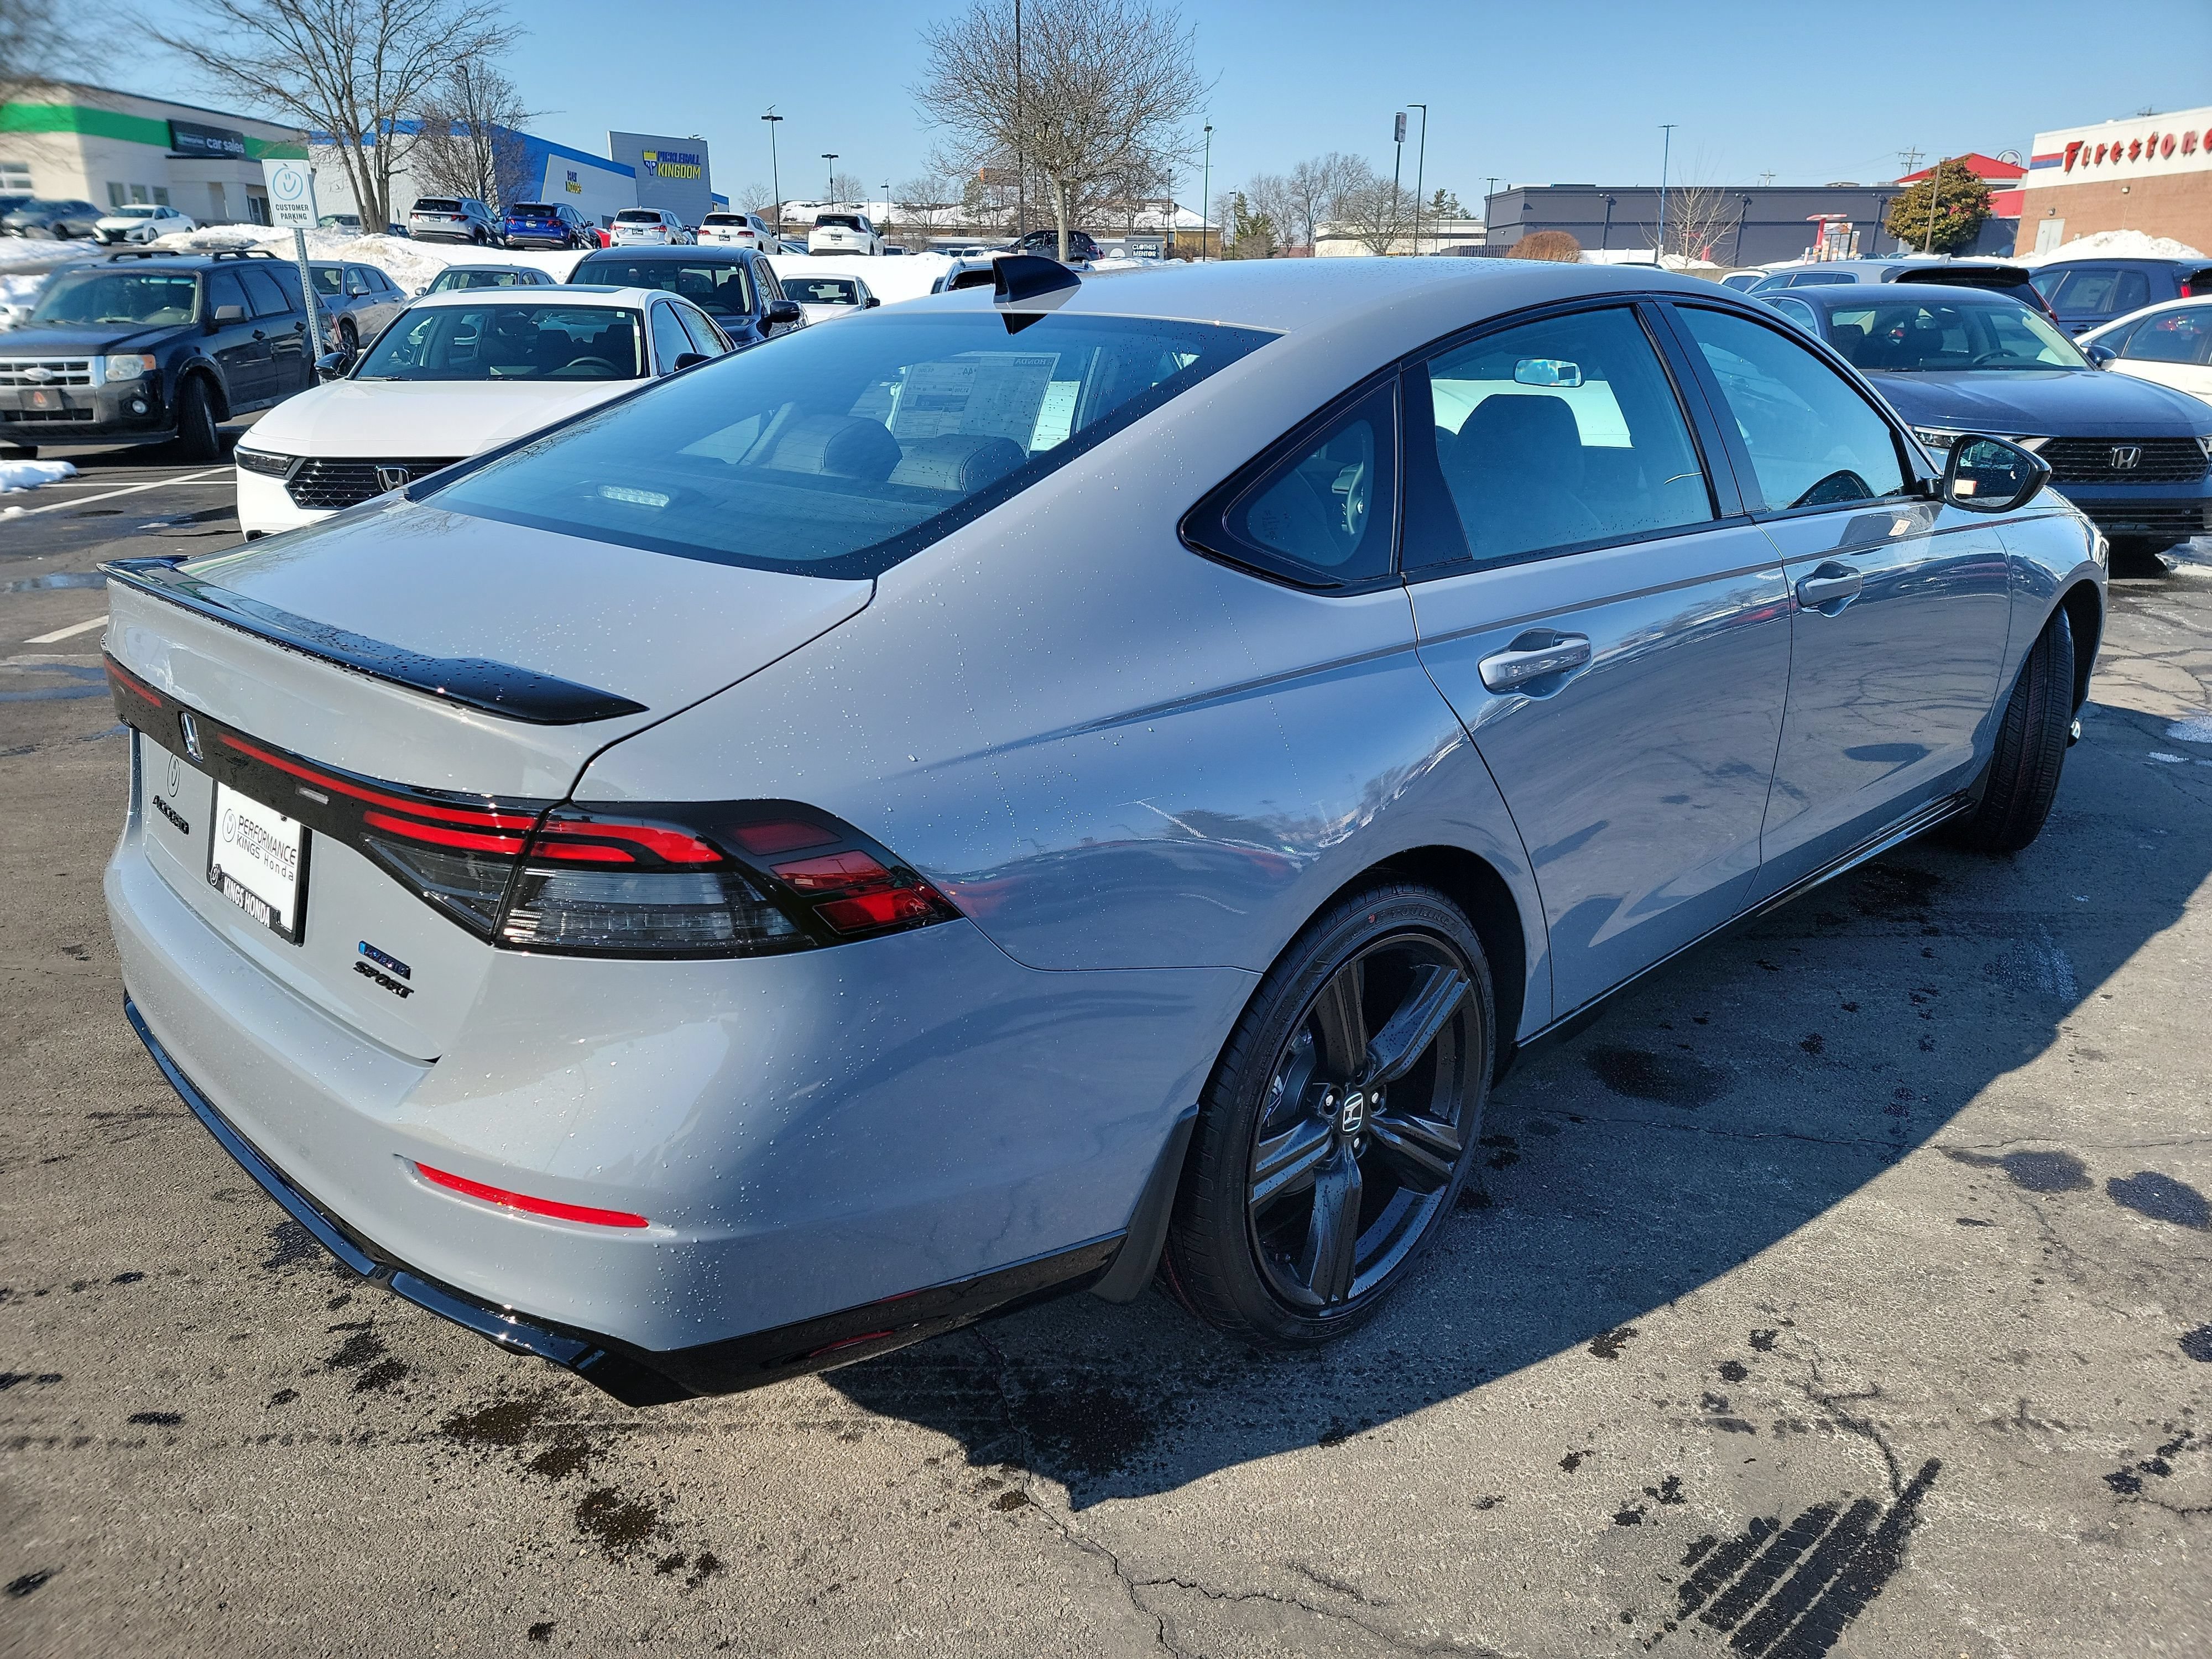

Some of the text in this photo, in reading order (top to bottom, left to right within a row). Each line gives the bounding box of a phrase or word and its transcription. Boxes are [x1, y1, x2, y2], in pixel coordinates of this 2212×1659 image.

[206, 138, 222, 150] car
[223, 138, 244, 153] sales
[658, 151, 701, 165] PICKLEBALL
[2063, 128, 2212, 174] Firestone
[657, 163, 701, 180] KINGDOM
[236, 834, 294, 881] KINGS Honda
[238, 815, 297, 865] PERFORMANCE
[223, 875, 271, 928] KINGS HONDA
[353, 961, 414, 999] SPORT
